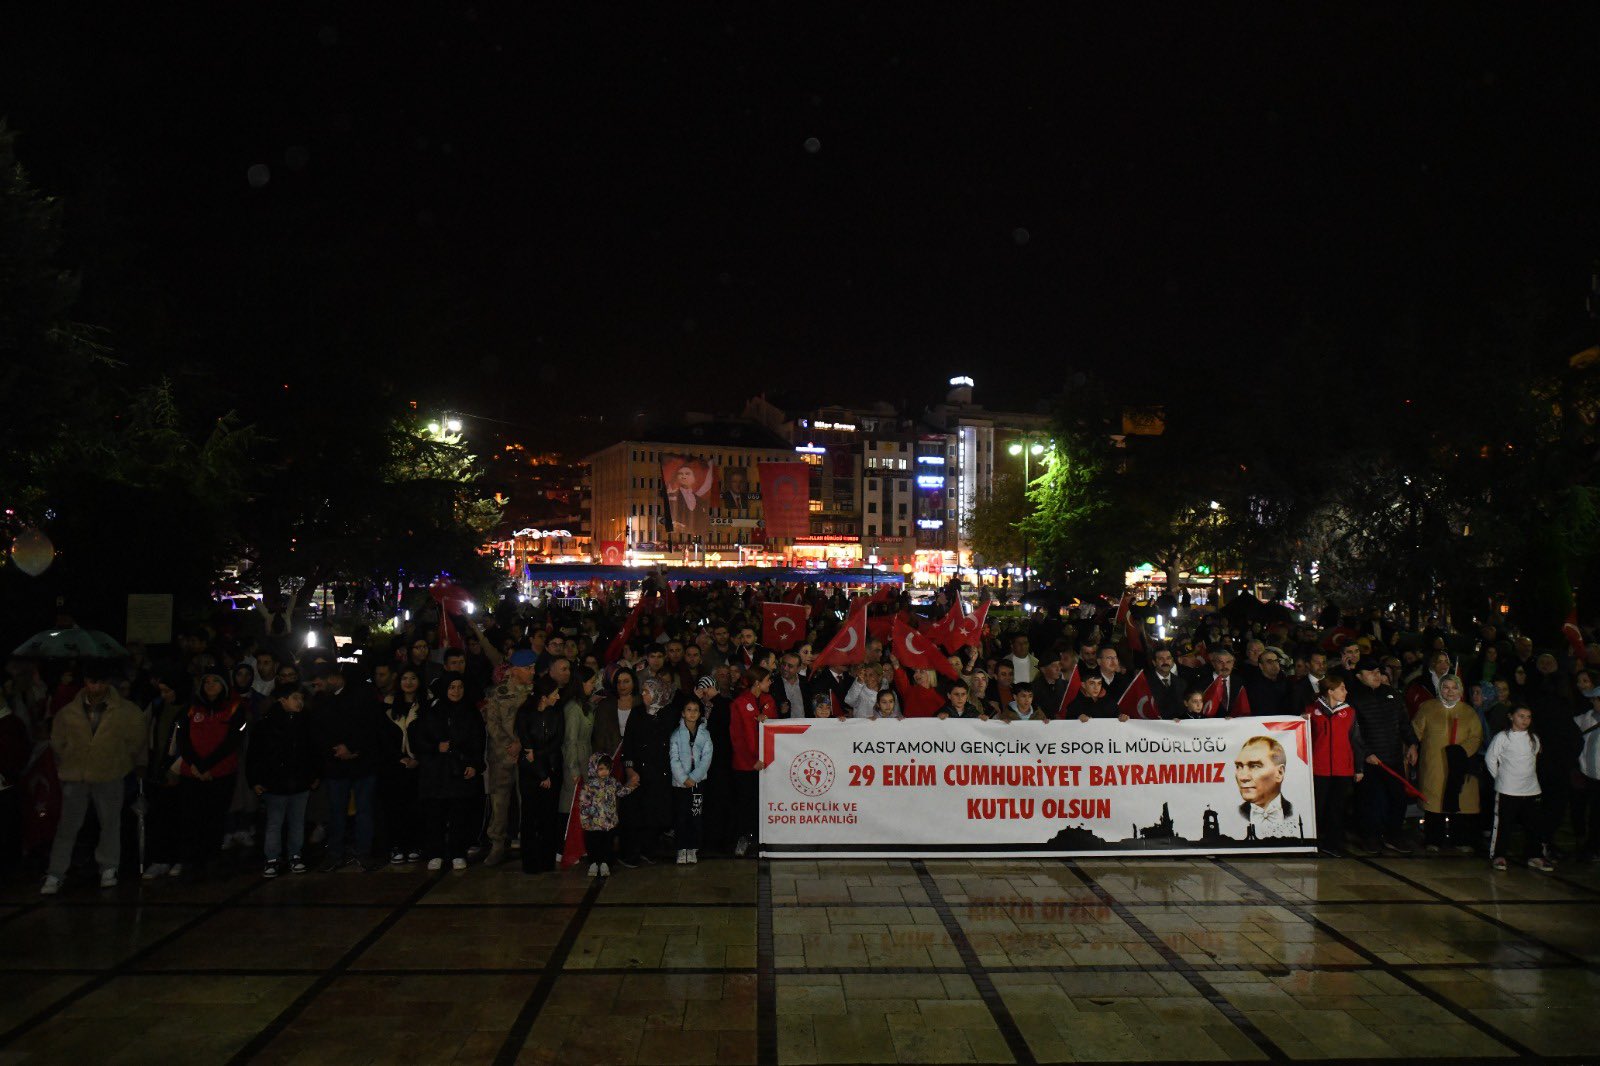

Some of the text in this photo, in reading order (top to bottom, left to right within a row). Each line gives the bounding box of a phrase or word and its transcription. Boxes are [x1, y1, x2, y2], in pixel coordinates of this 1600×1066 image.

[853, 737, 1227, 757] KASTAMONU GENÇLİK VE SPOR İL MÜDÜRLÜĞÜ
[848, 760, 1226, 787] 29 EKİM CUMHURİYET BAYRAMIMIZ
[768, 801, 858, 813] T.C. GENÇLİK VE
[967, 798, 1111, 820] KUTLU OLSUN
[768, 813, 858, 825] SPOR BAKANLIĞI
